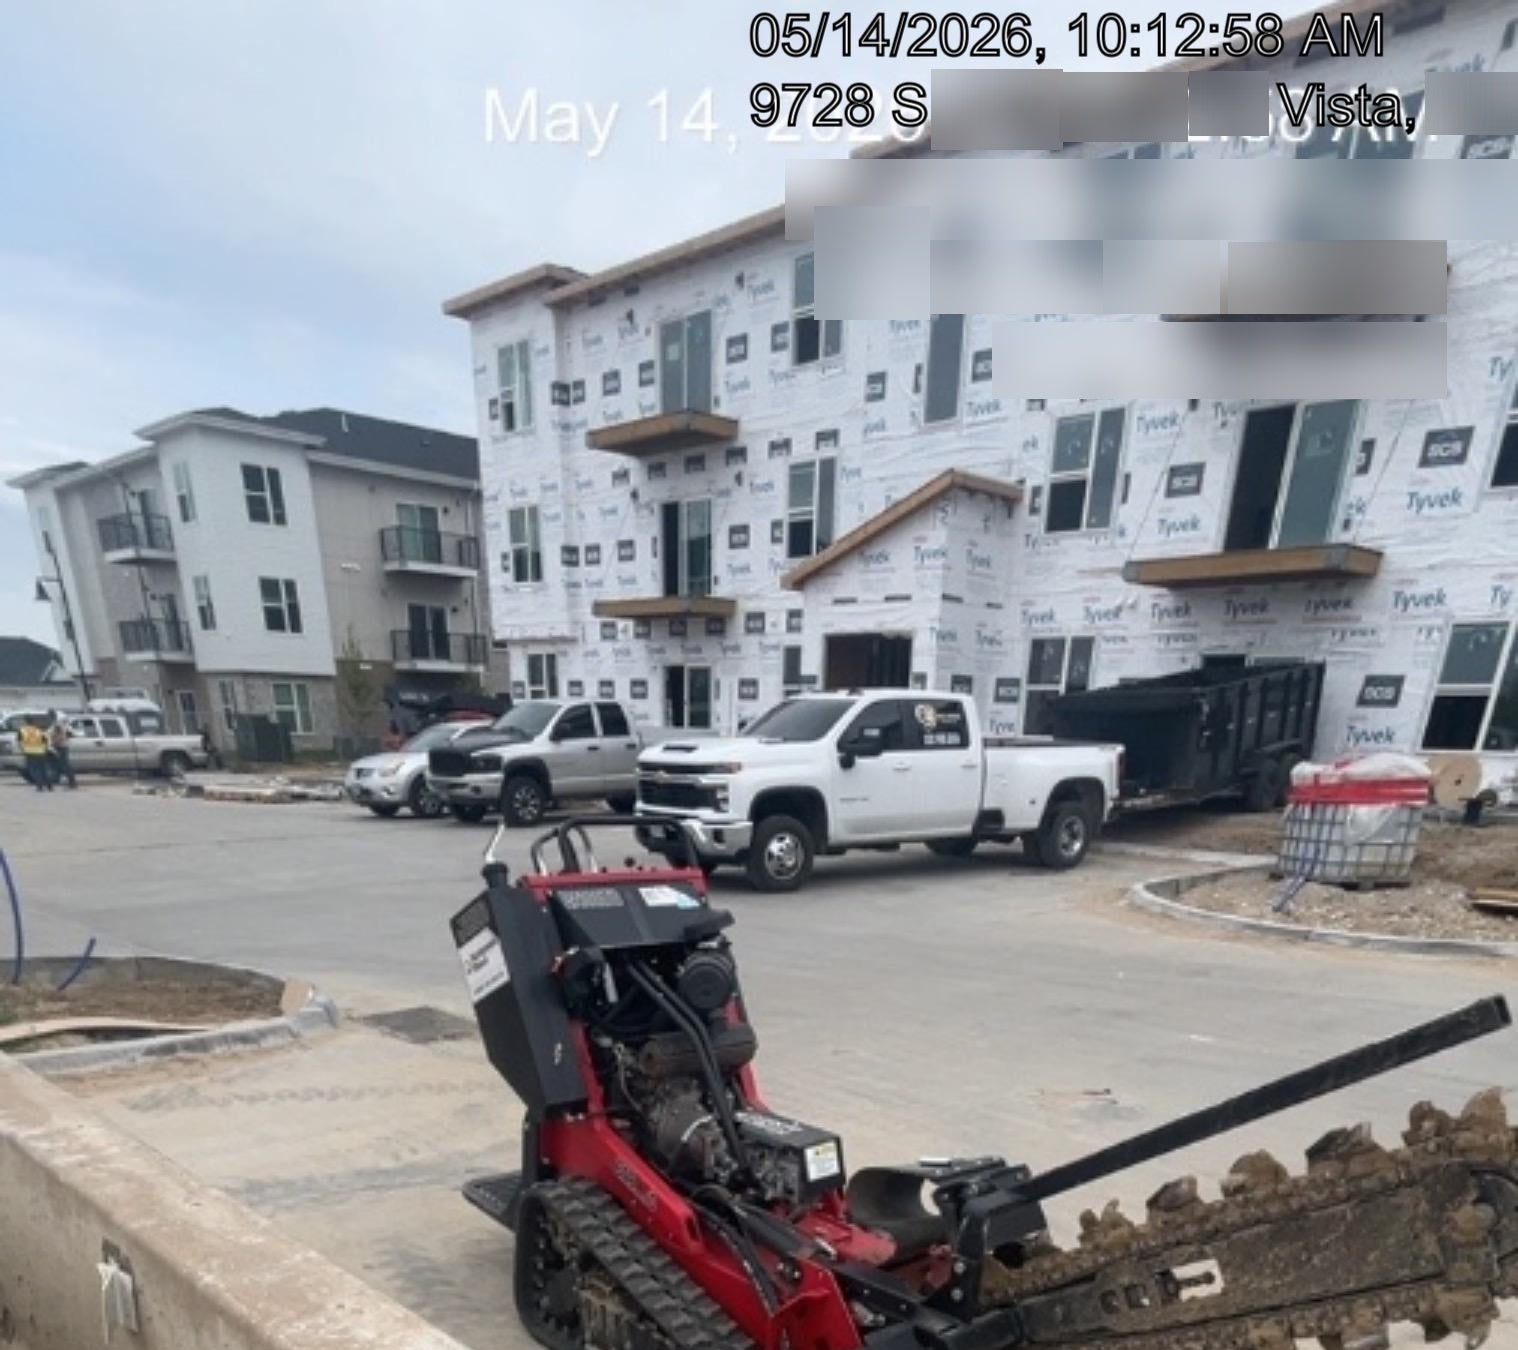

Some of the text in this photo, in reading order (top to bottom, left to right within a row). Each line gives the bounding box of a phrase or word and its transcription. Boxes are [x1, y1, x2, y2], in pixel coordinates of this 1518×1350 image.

[1407, 487, 1462, 514] Tyvek
[1394, 588, 1447, 611] Tyvek
[1347, 725, 1395, 744] Tyvek
